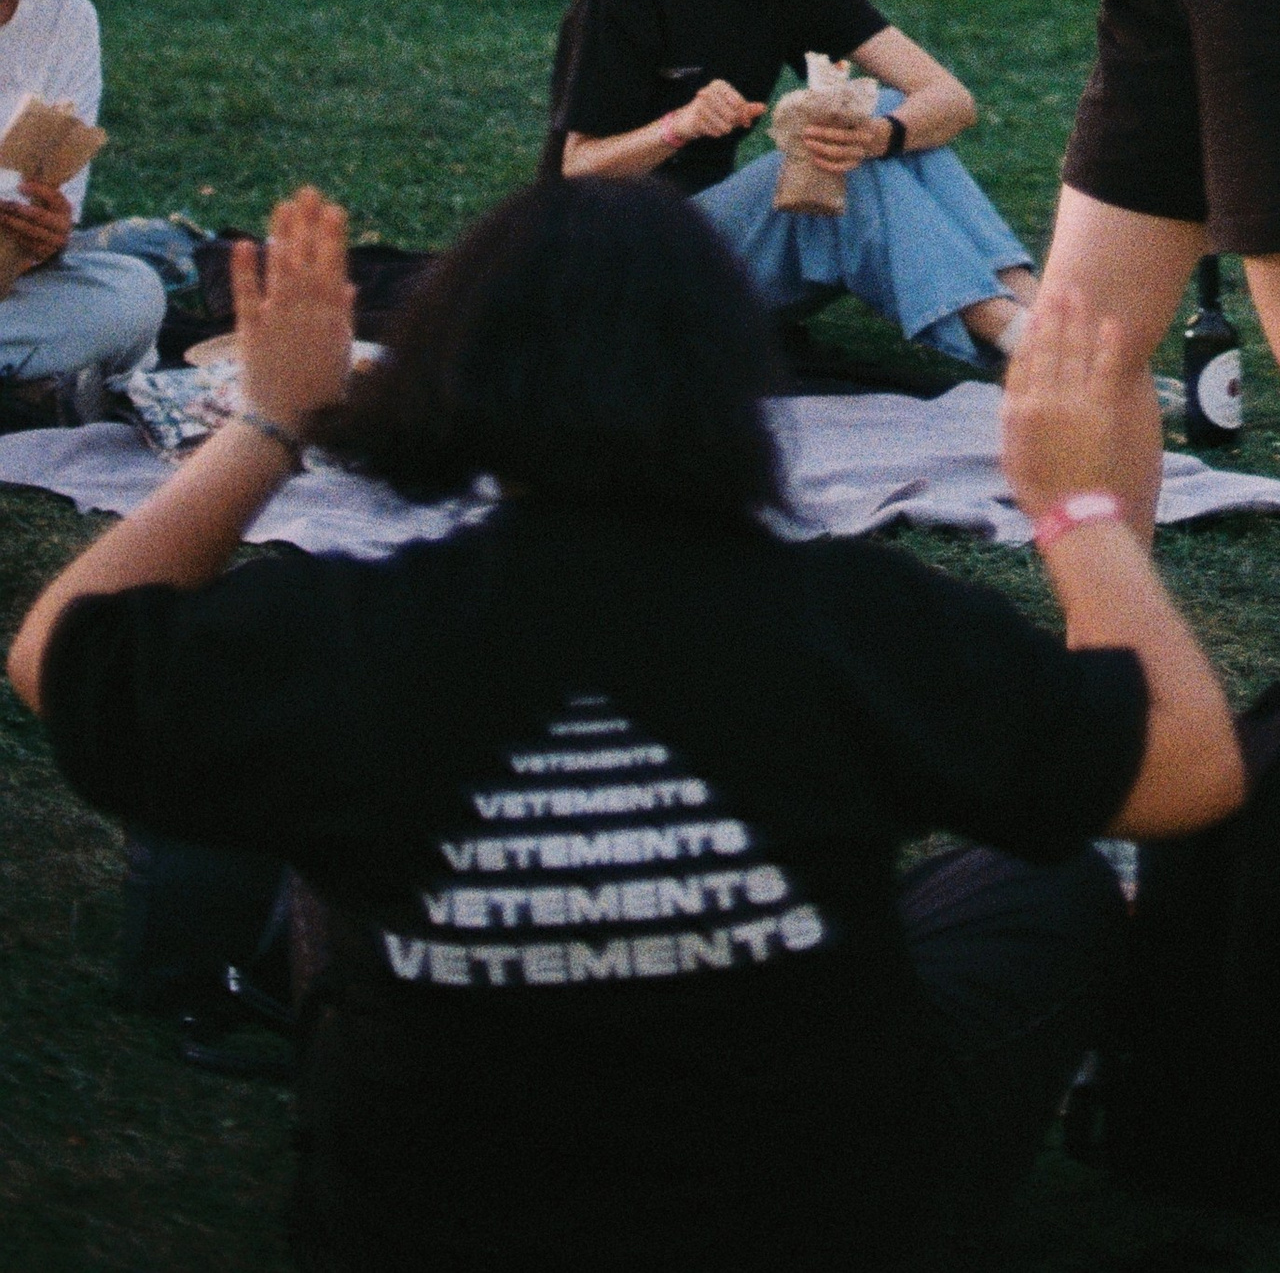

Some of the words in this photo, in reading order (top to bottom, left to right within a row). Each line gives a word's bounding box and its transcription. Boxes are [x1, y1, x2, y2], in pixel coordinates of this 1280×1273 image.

[472, 777, 711, 820] VETEMENTS
[440, 818, 752, 871] VETEMENTS
[423, 864, 789, 929] VETEMENTS
[383, 903, 826, 986] VETEMENTS
